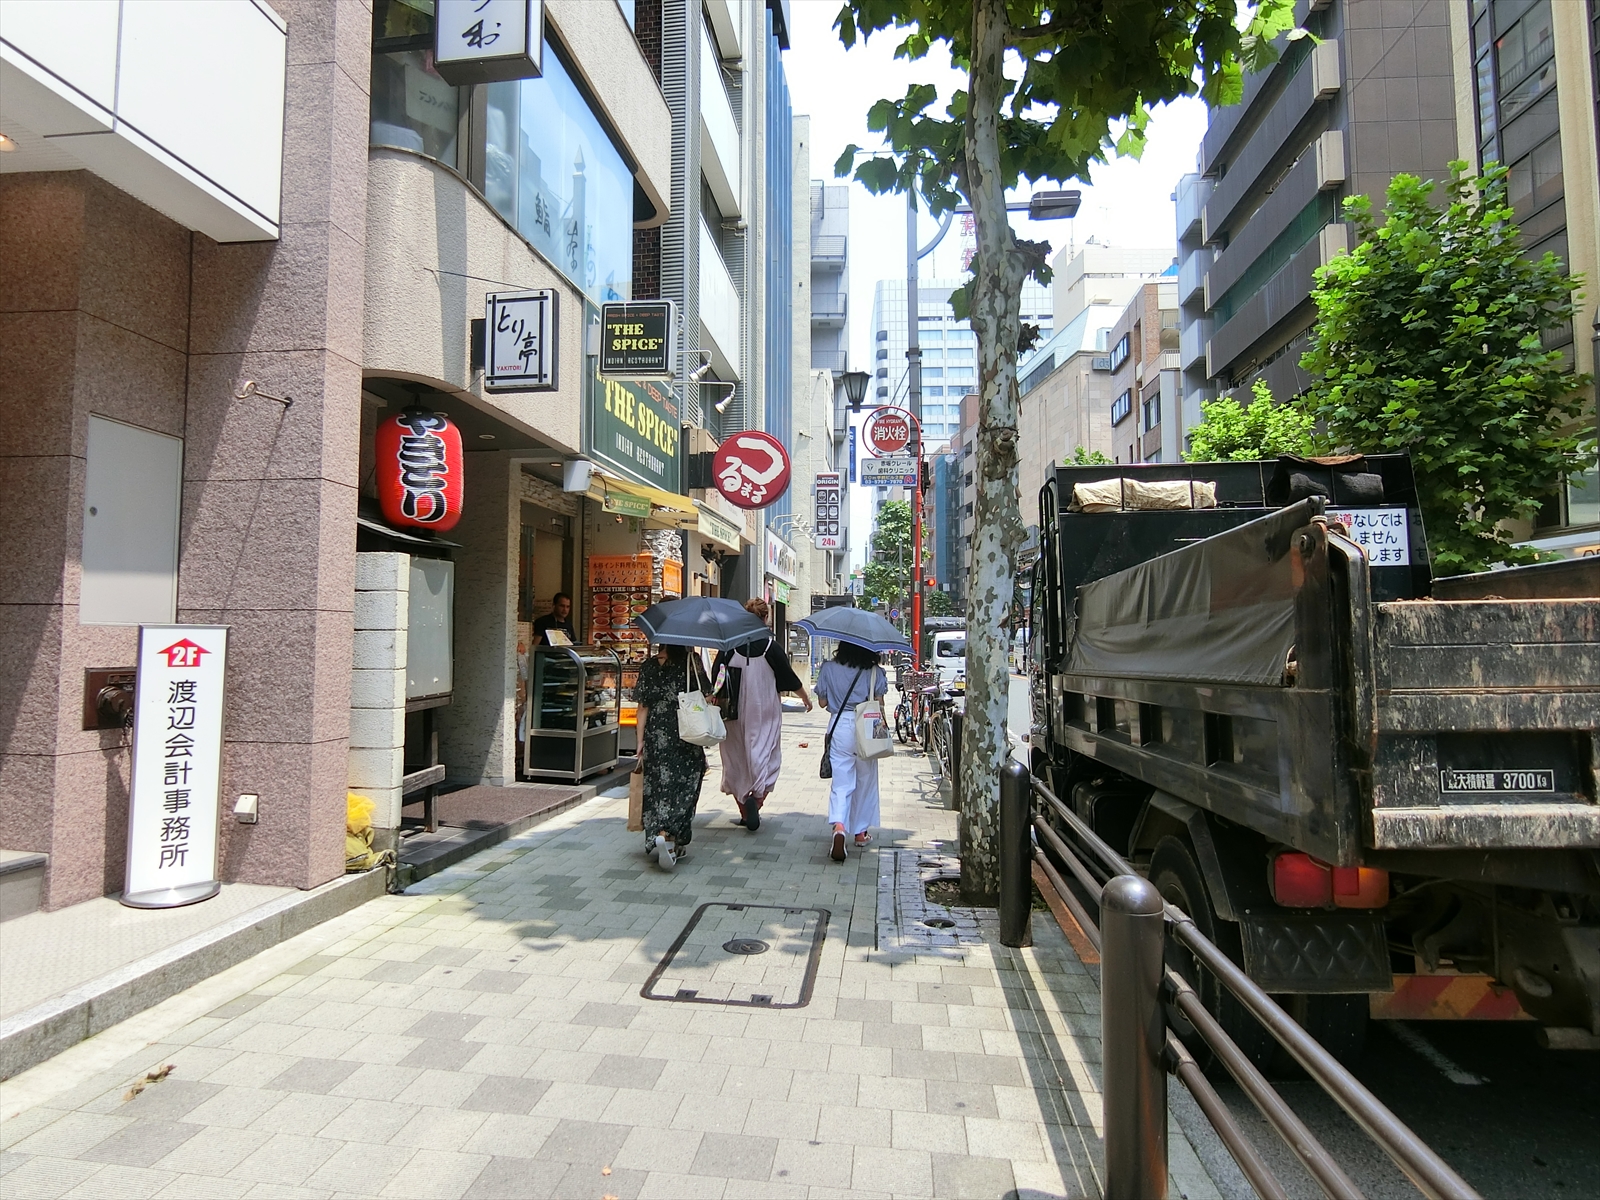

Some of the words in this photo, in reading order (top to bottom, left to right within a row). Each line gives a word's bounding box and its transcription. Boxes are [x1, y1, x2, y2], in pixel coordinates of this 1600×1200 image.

[497, 306, 538, 373] とり亭
[662, 396, 678, 419] TASTE
[873, 425, 907, 441] 消火栓
[396, 411, 449, 522] やきとり
[636, 445, 666, 477] RESTAURANT
[821, 537, 836, 546] 24h
[172, 645, 199, 666] 2F
[158, 679, 198, 869] 渡辺会計事務所
